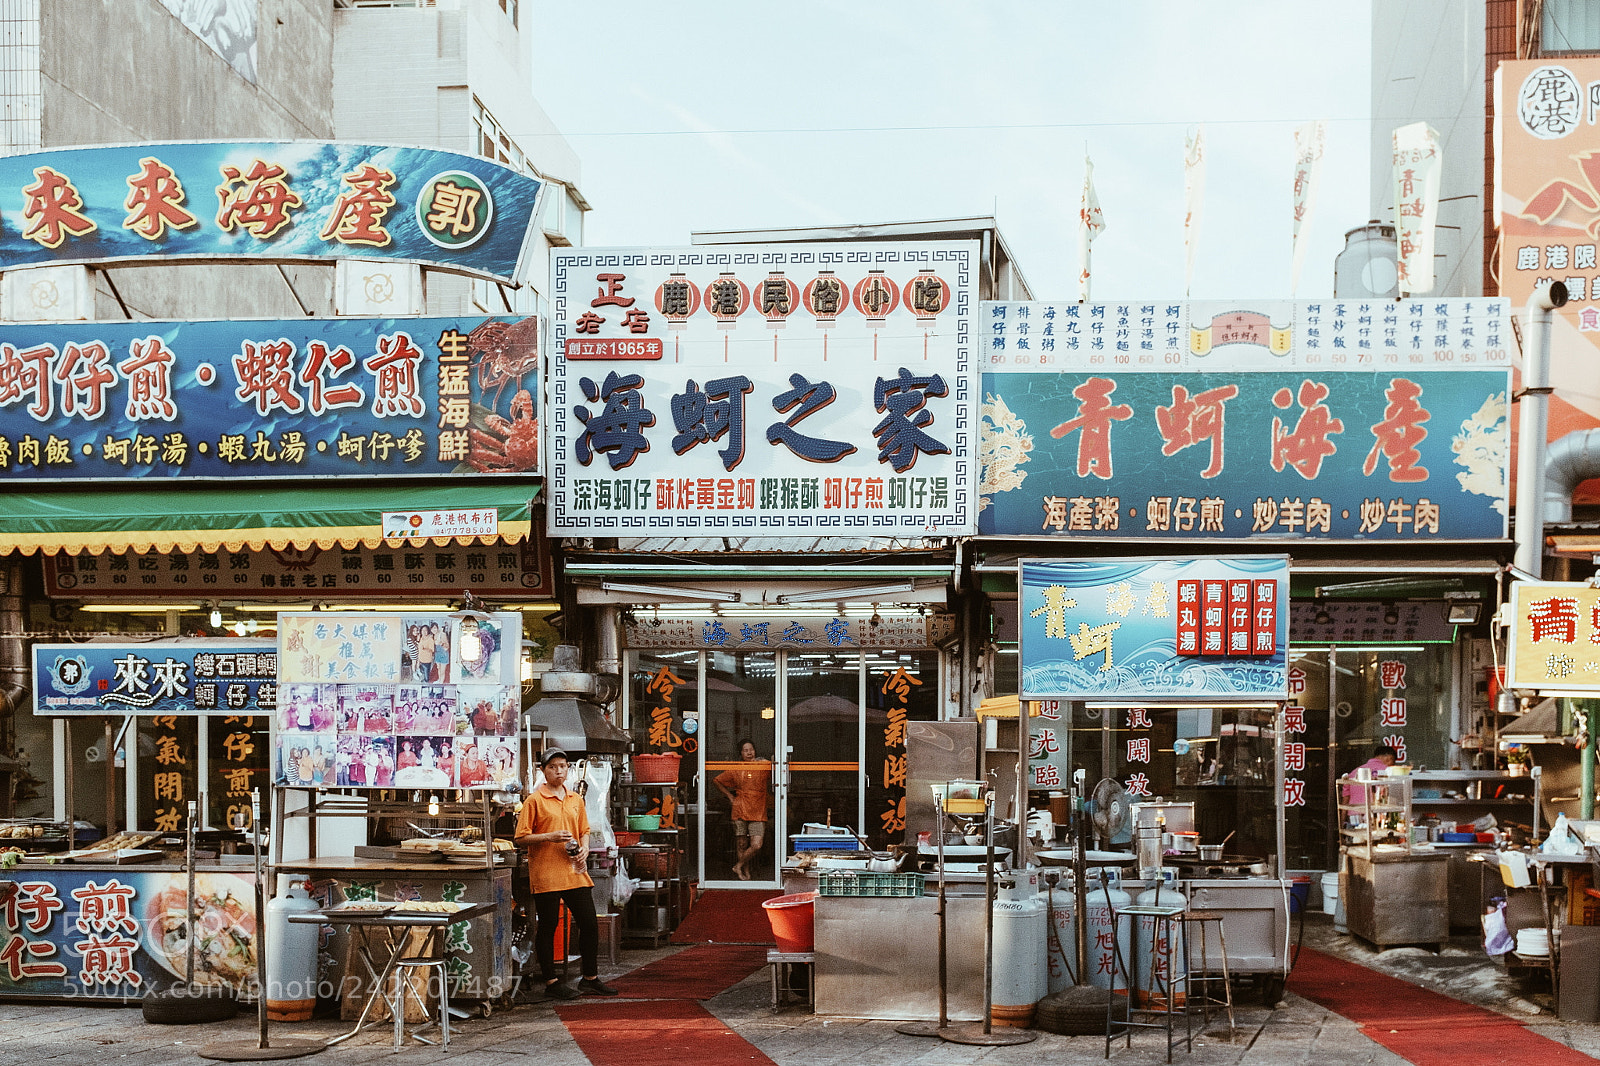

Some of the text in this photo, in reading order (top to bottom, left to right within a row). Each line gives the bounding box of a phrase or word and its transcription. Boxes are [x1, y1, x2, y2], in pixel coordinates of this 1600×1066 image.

[1526, 70, 1575, 134] 鹿港
[21, 157, 478, 250] 來來海產 郭
[591, 274, 635, 308] 正
[660, 279, 943, 314] 鹿港民俗小吃
[576, 307, 650, 334] 老店
[568, 342, 659, 356] 創立於1965年
[1434, 350, 1453, 362] 100
[1484, 349, 1506, 360] 100
[1164, 353, 1181, 363] 60
[1358, 354, 1372, 363] 70
[1461, 354, 1477, 363] 150
[0, 331, 425, 422] 蚵仔煎 蝦仁煎
[438, 330, 470, 462] 生猛海鮮
[574, 367, 951, 473] 海蚵之家
[1050, 377, 1430, 482] 青蚵海產
[573, 478, 948, 510] 深海蚵仔 酥炸黃金蚵 蝦猴酥 蚵仔煎 蚵仔湯
[432, 512, 493, 525] 鹿港帆布行
[83, 575, 96, 584] 25
[113, 575, 126, 584] 80
[142, 575, 156, 584] 100
[174, 575, 187, 583] 40
[203, 575, 217, 583] 60
[234, 574, 247, 583] 60
[346, 574, 359, 583] 60
[378, 574, 391, 583] 60
[408, 574, 424, 583] 150
[439, 574, 454, 583] 150
[471, 574, 484, 582] 60
[501, 573, 514, 582] 60
[1180, 583, 1196, 651] 蝦丸湯
[1205, 583, 1222, 651] 青蚵湯
[1231, 583, 1248, 651] 蚵仔麵
[1257, 583, 1272, 651] 蚵仔煎
[315, 623, 388, 640] 各大媒體
[702, 618, 853, 646] 海蚵之家
[113, 654, 188, 697] 來來
[646, 666, 686, 829] 冷氣放
[0, 932, 143, 988] 仁煎
[1095, 931, 1118, 975] 旭光
